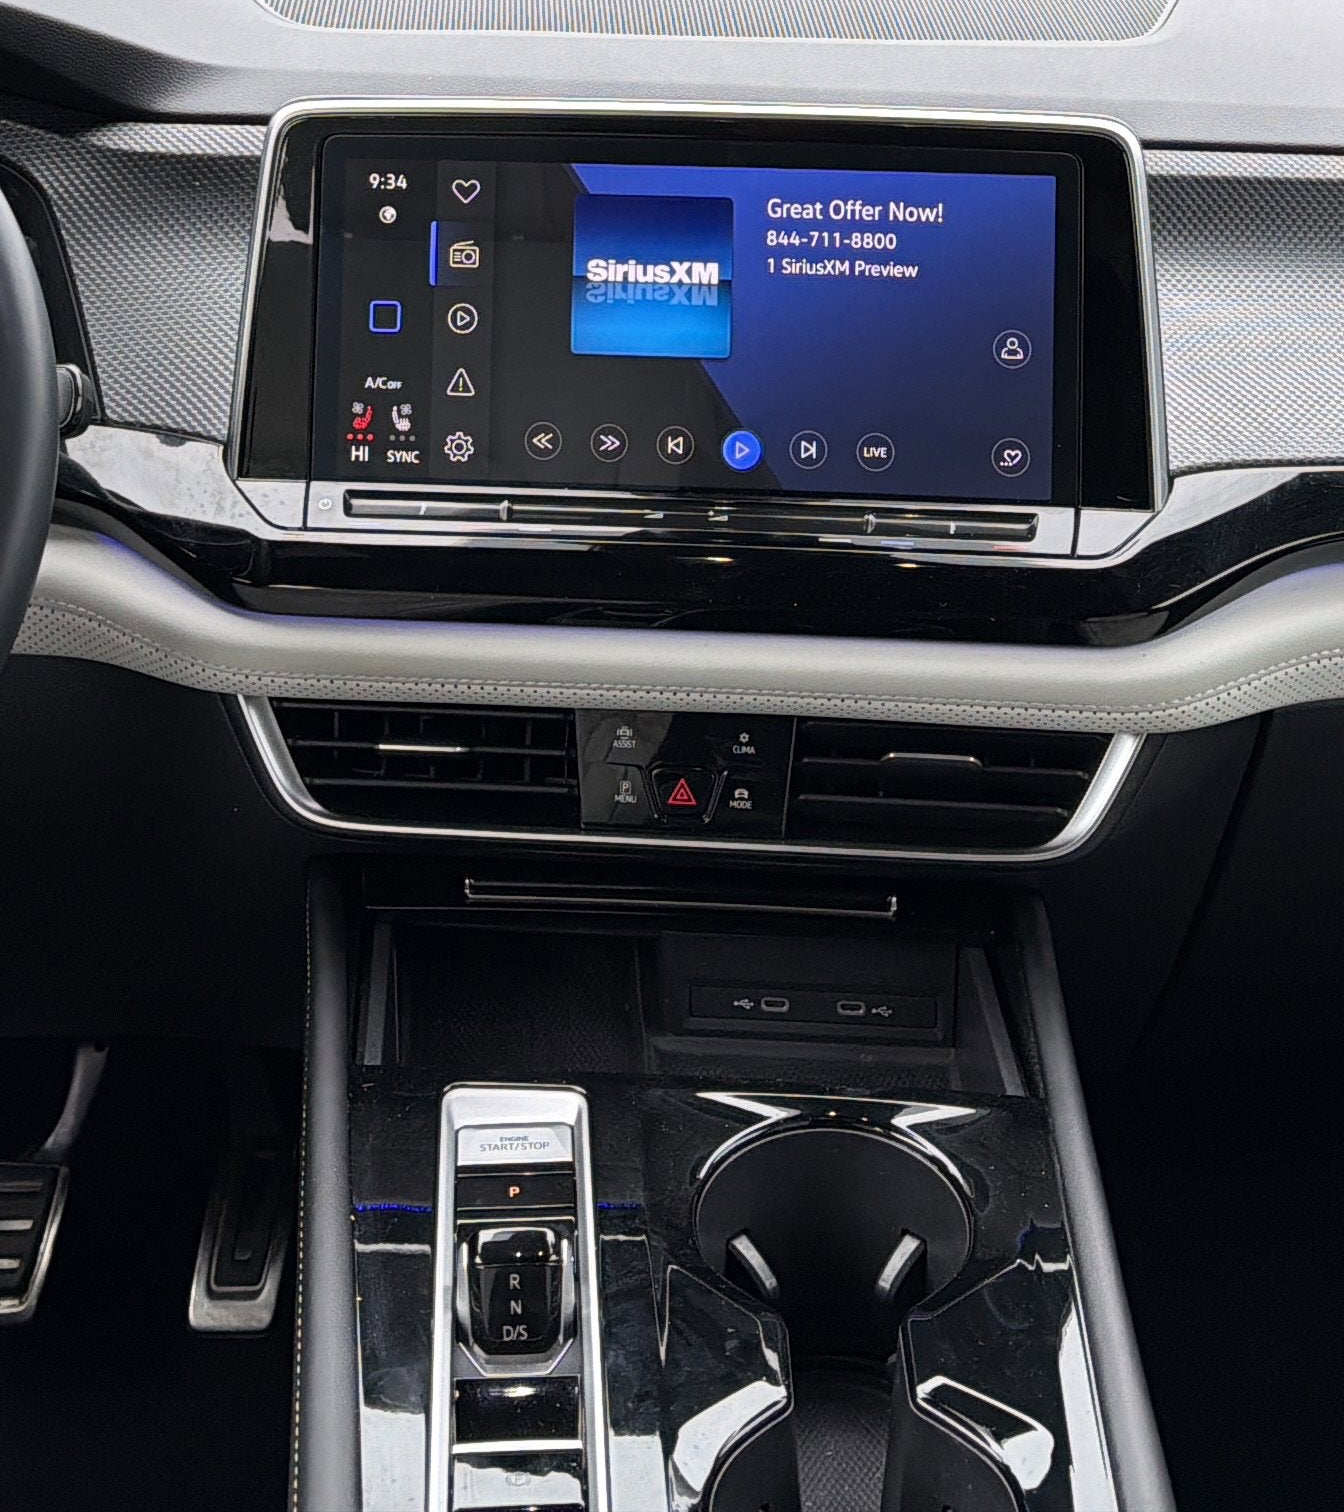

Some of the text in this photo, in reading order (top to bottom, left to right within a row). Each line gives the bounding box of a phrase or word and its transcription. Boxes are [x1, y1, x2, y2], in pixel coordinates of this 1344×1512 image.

[369, 172, 408, 190] 9:34
[767, 197, 944, 224] Great Offer Now!
[766, 230, 897, 250] 844-711-8800
[586, 258, 719, 285] SiriusXM
[767, 257, 919, 278] 1 SiriusXM Preview
[350, 445, 369, 462] HI
[386, 449, 421, 464] SYNC
[863, 446, 888, 459] LIVE
[612, 739, 636, 749] ASSIST
[732, 745, 756, 755] CLIMA
[614, 794, 638, 804] MENU
[729, 800, 753, 810] MODE
[479, 1141, 550, 1152] START/STOP
[509, 1186, 521, 1198] P
[509, 1273, 521, 1290] R
[510, 1299, 522, 1315] N
[502, 1325, 529, 1342] D/S
